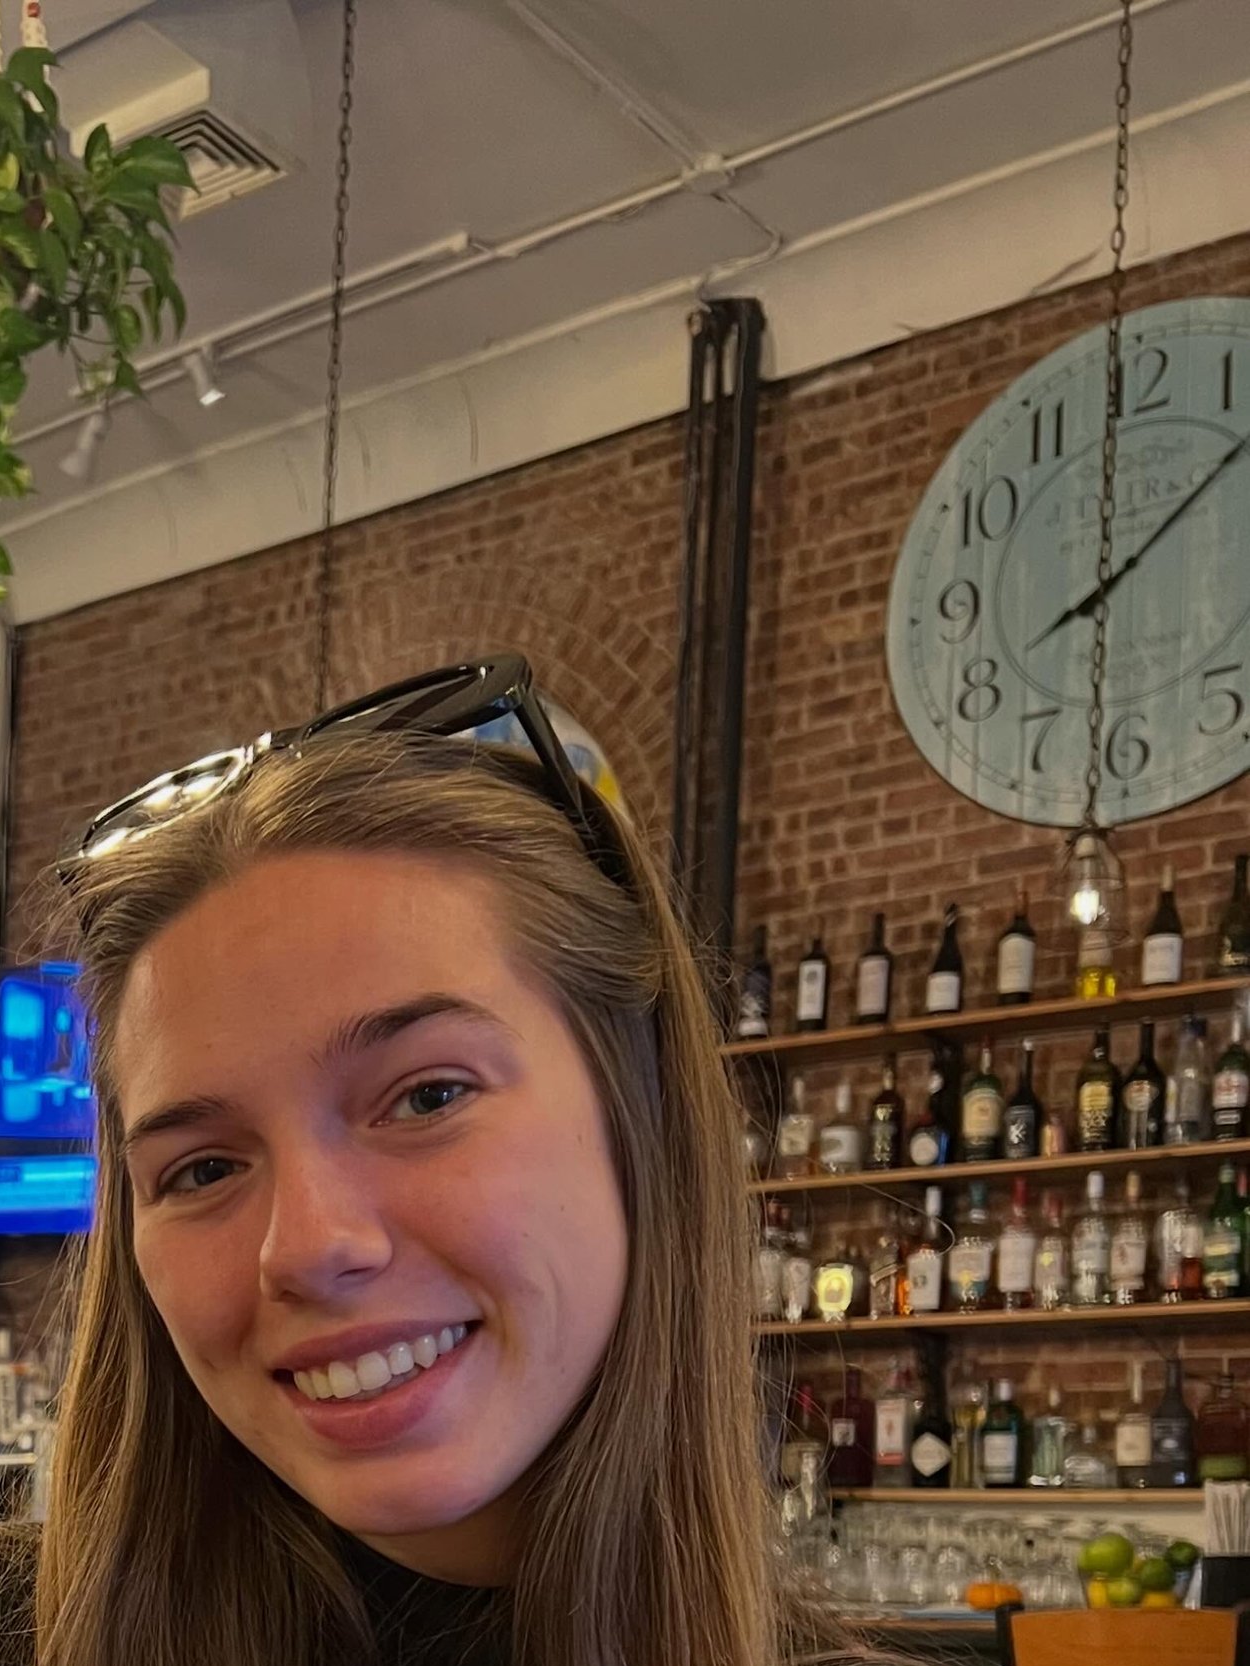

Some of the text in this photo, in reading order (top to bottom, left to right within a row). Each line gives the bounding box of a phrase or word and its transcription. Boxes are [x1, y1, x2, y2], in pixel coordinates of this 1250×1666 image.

[1113, 347, 1172, 417] 12
[1031, 398, 1064, 465] 11
[962, 474, 1018, 548] 10
[938, 578, 980, 644] 9
[957, 657, 1002, 723] 8
[1197, 663, 1243, 736] 5
[1022, 708, 1061, 773] 7
[1105, 714, 1150, 780] 6
